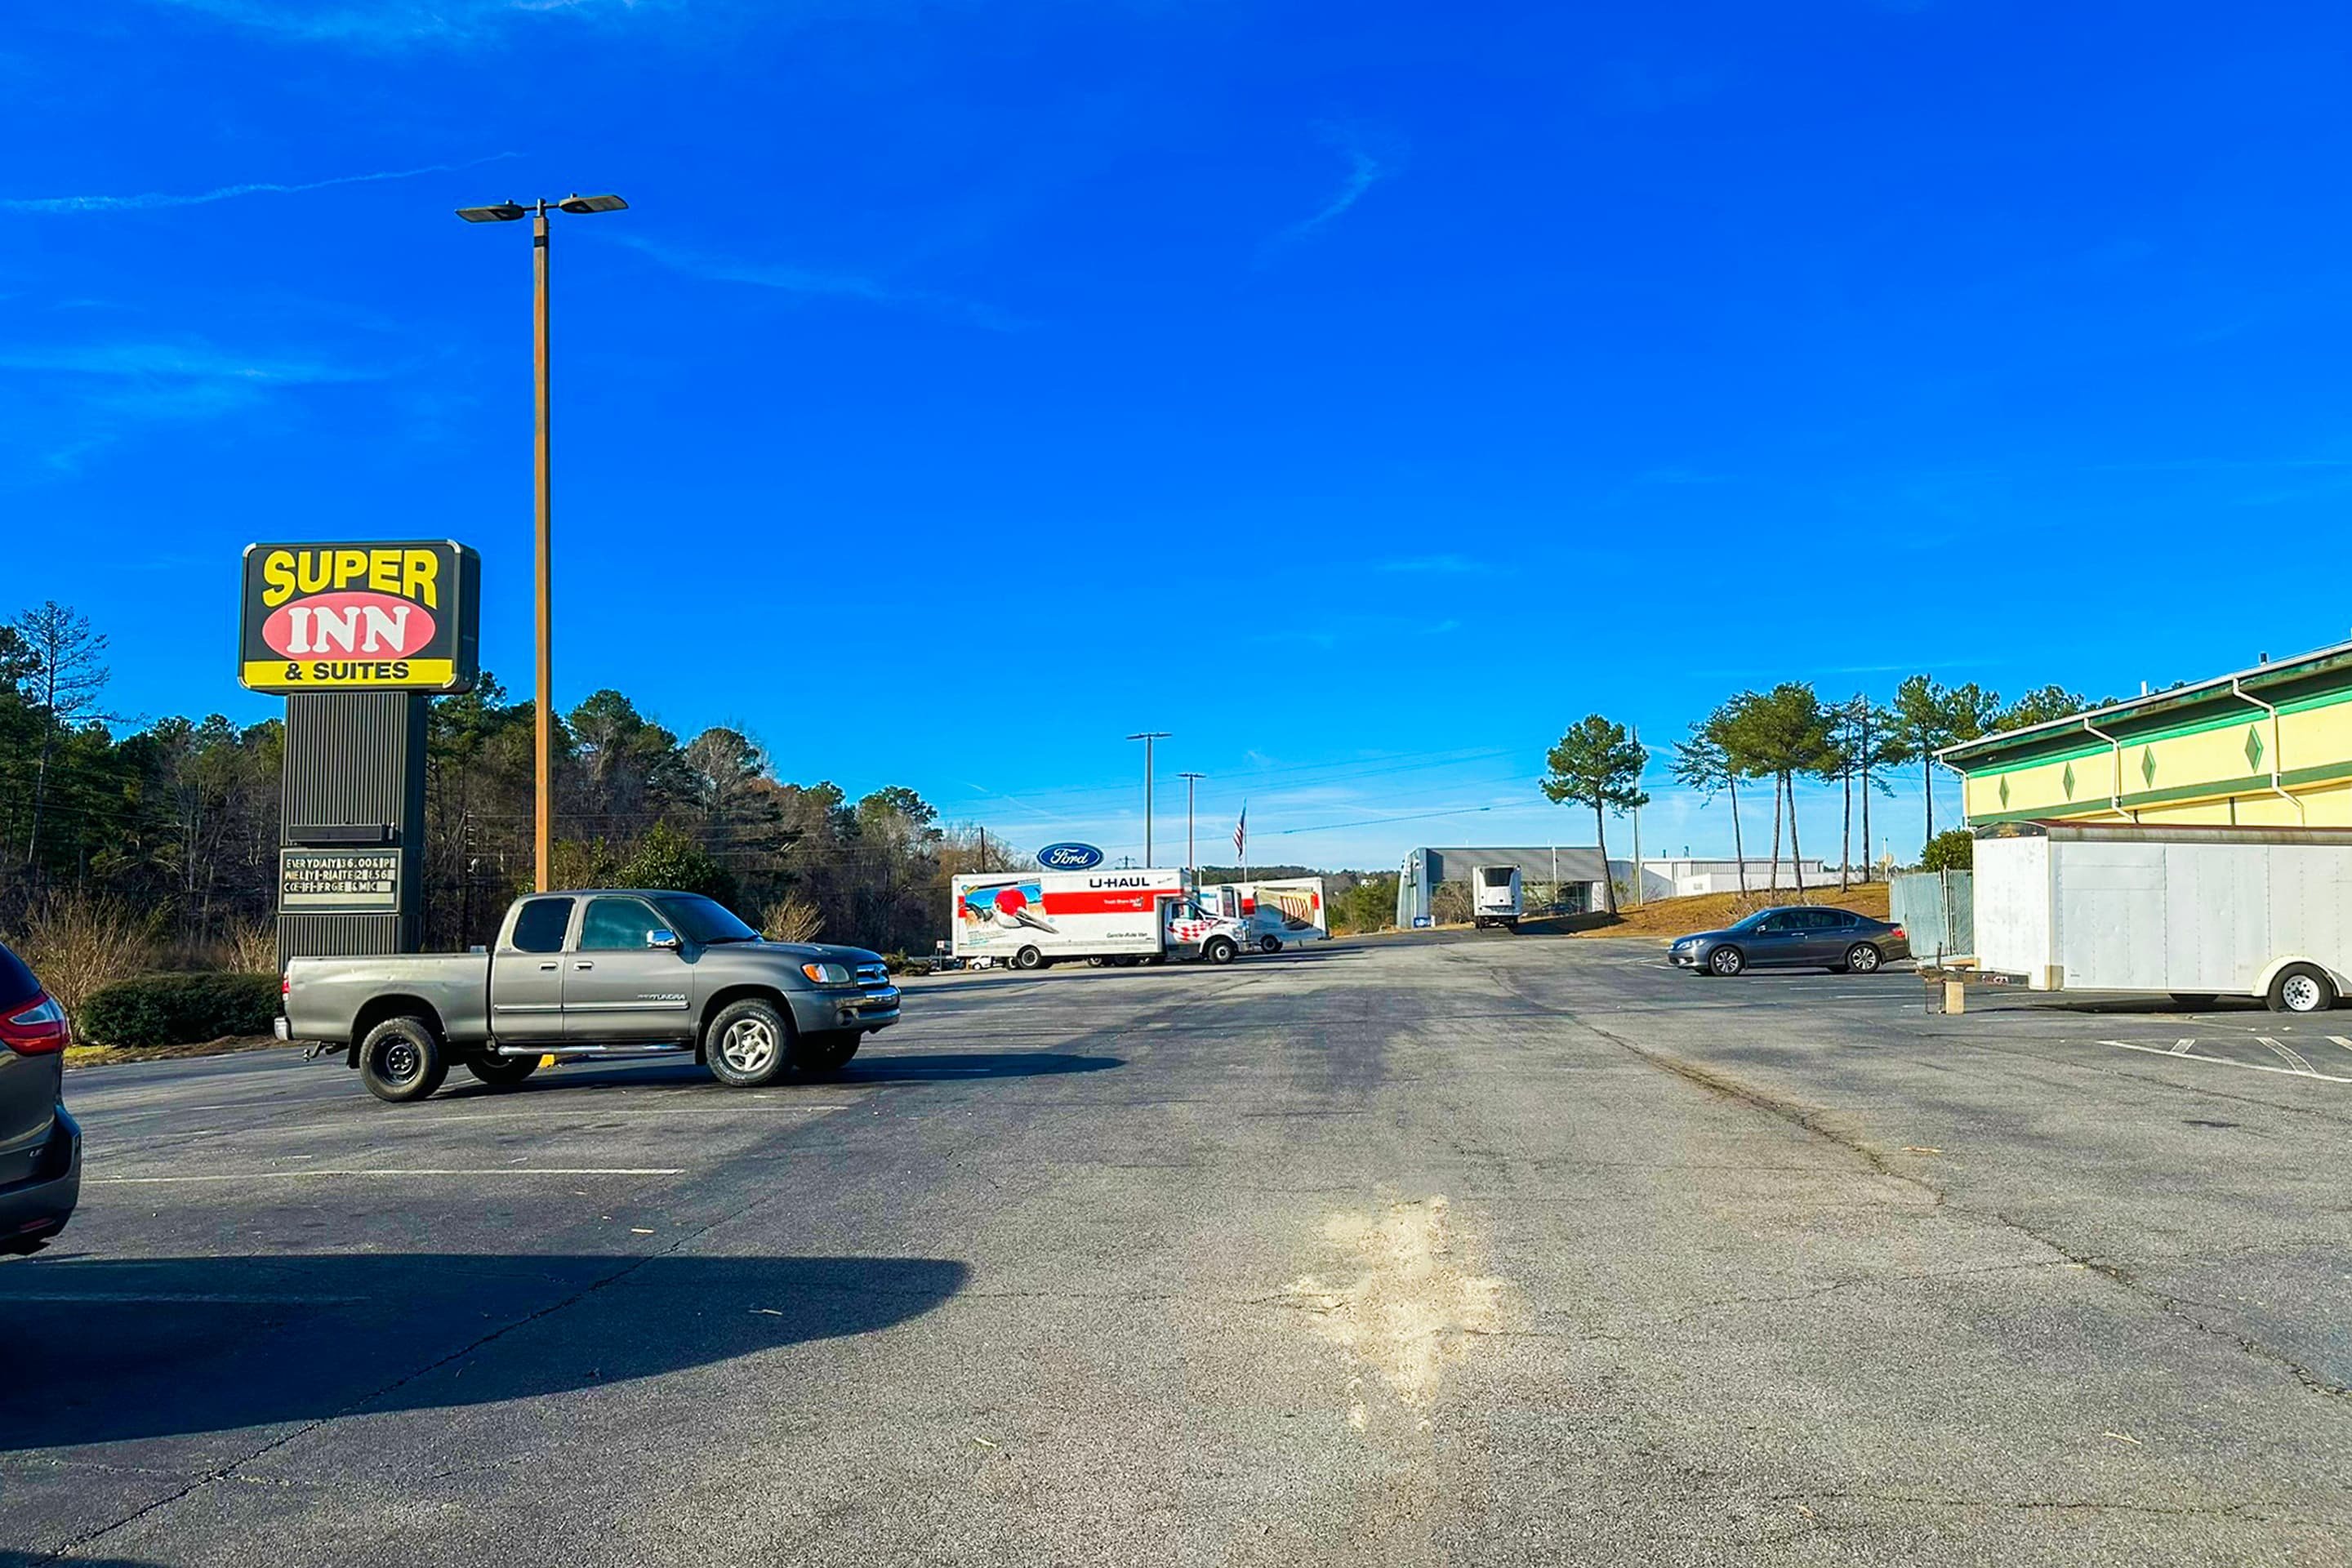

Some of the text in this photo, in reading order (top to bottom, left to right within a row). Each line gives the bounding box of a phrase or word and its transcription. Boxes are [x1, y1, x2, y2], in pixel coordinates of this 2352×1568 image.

[262, 549, 439, 610] SUPER
[286, 606, 411, 653] INN
[284, 662, 409, 680] & SUITES
[1050, 848, 1089, 865] Ford
[1089, 876, 1150, 888] U-HAUL
